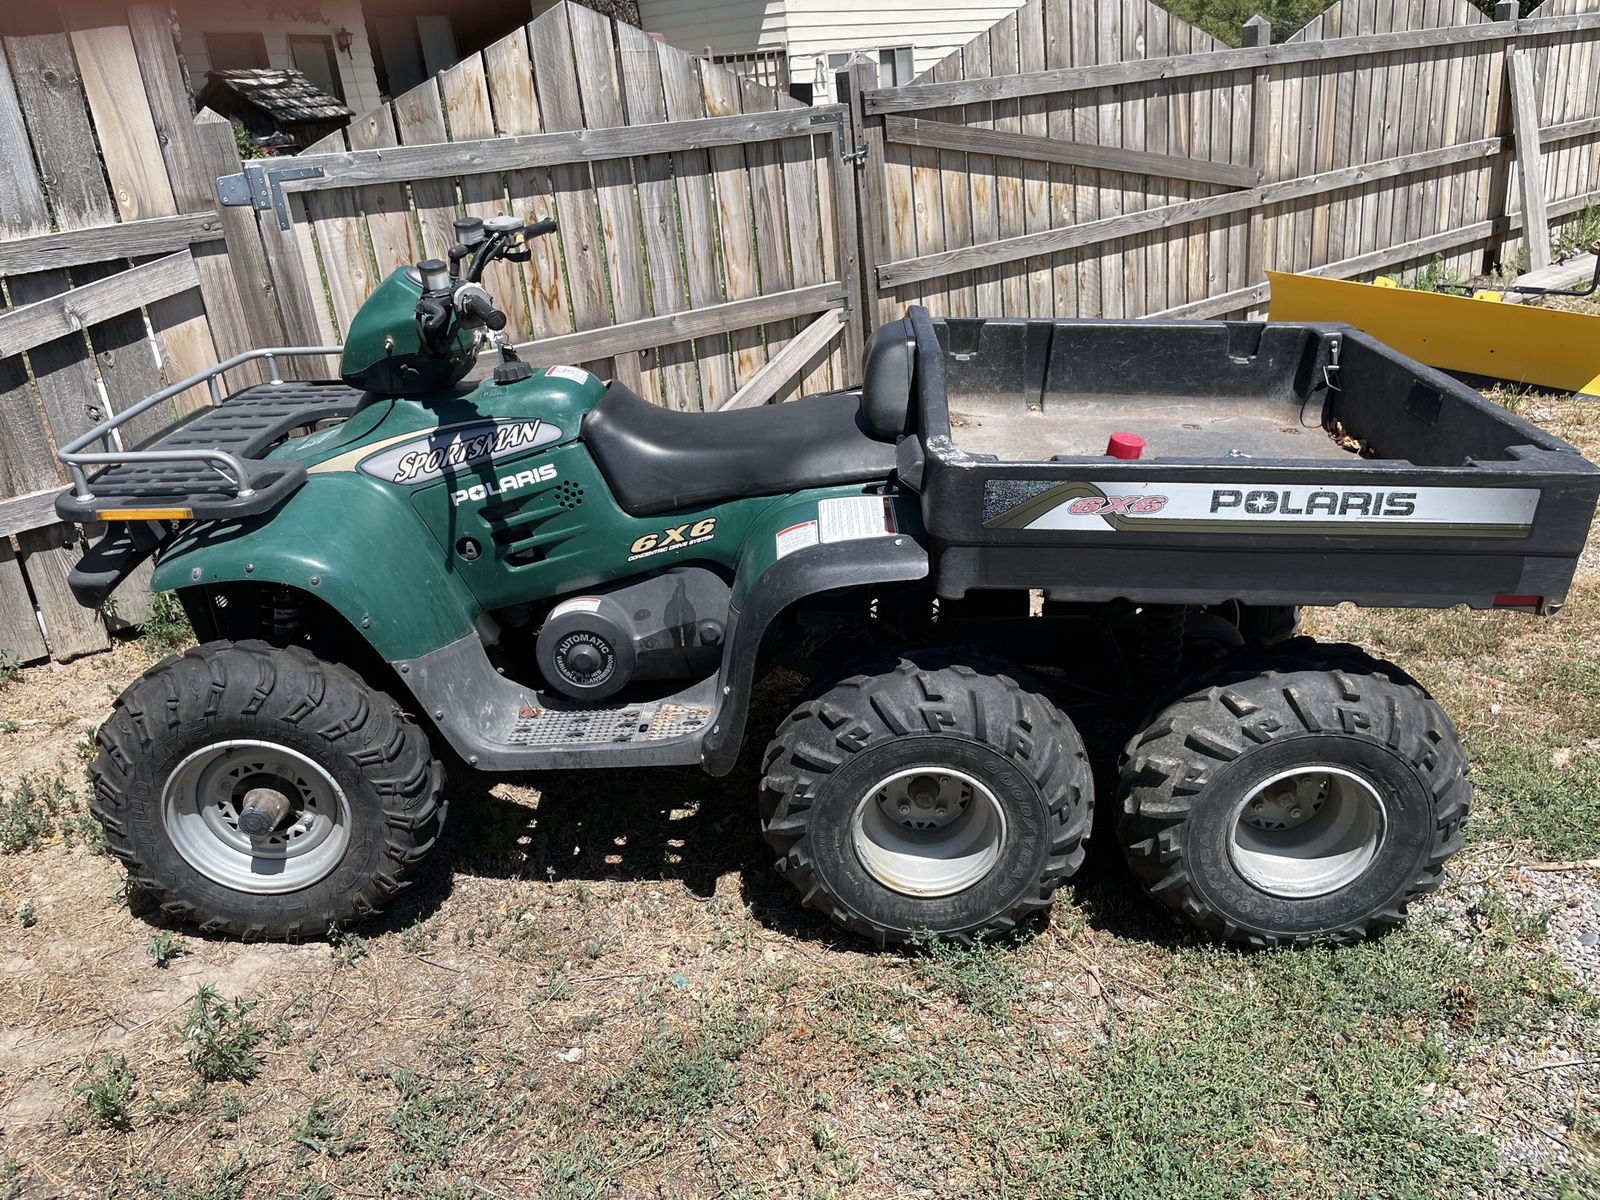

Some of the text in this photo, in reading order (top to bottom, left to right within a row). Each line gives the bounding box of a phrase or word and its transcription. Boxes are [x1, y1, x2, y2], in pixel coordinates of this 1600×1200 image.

[394, 418, 541, 482] SPORTSMAN
[451, 463, 558, 507] POLARIS
[1067, 494, 1169, 516] 6X6
[1209, 489, 1418, 516] POLARIS
[628, 534, 715, 561] CONCENTRIC DRIVE SYSTEM
[631, 517, 717, 553] 6X6
[560, 634, 609, 654] AUTOMATIC
[556, 656, 577, 682] VARIABLE
[983, 761, 1038, 897] GOODYEAR
